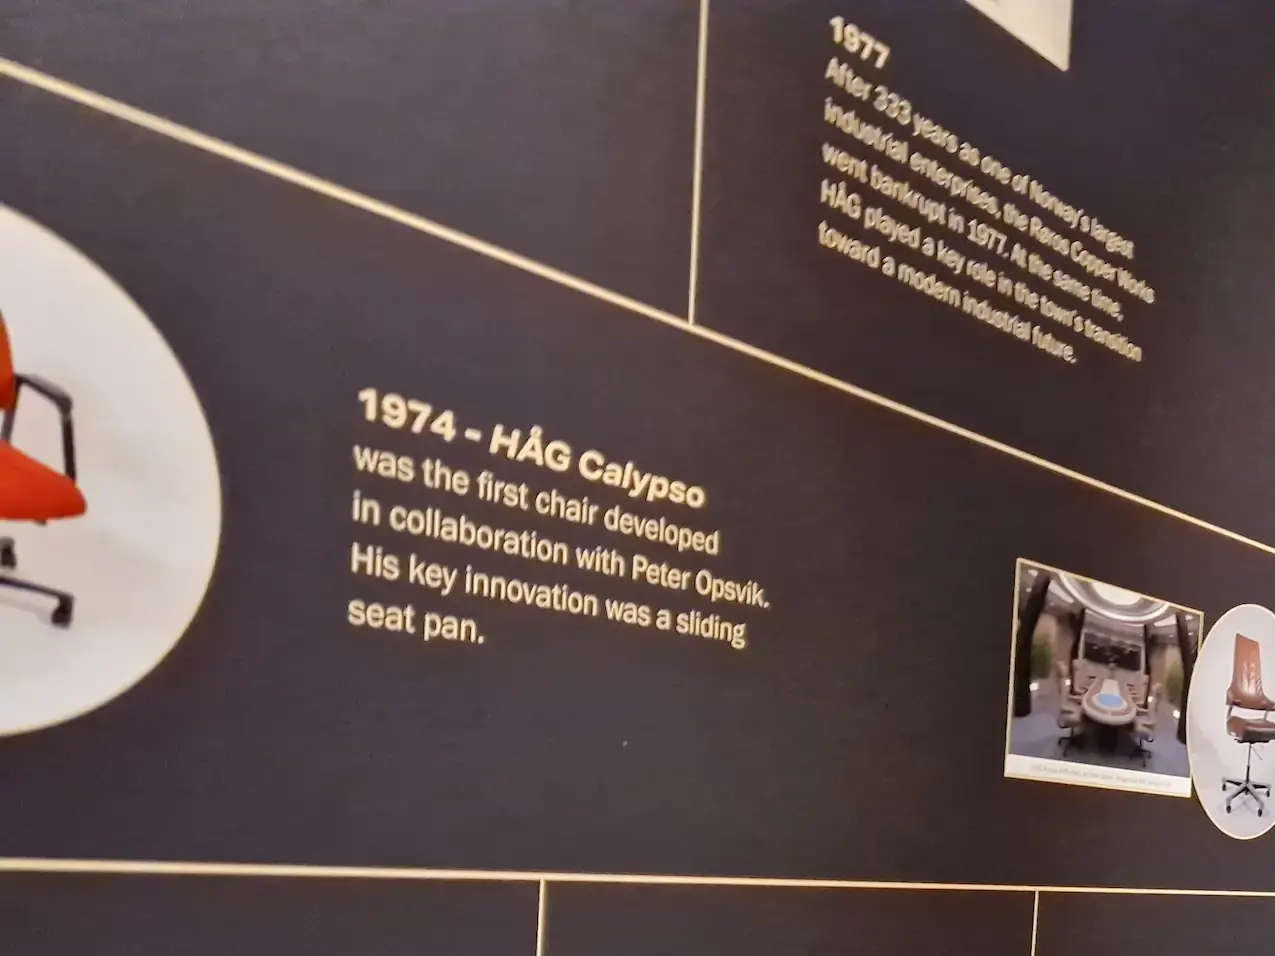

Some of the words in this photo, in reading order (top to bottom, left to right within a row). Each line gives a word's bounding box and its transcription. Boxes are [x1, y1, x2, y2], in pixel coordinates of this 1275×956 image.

[829, 16, 891, 70] 1977
[825, 59, 872, 100] After
[874, 86, 911, 125] 333
[912, 114, 958, 153] years
[959, 142, 980, 166] as
[981, 156, 1010, 184] one
[1012, 175, 1031, 199] of
[1030, 180, 1089, 232] Norway's
[1089, 218, 1134, 259] largest
[825, 99, 908, 163] industrial
[910, 152, 1001, 219] enterprises,
[1003, 203, 1028, 231] the
[1071, 241, 1117, 280] Copper
[1118, 268, 1154, 303] Works
[821, 179, 861, 219] HÅG
[864, 207, 920, 249] played
[922, 237, 934, 256] a
[937, 240, 965, 274] key
[967, 260, 996, 287] role
[998, 272, 1012, 296] in
[1014, 282, 1039, 309] the
[1040, 296, 1083, 332] town's
[1083, 319, 1142, 362] transition
[823, 143, 867, 183] went
[871, 167, 946, 224] bankrupt
[948, 208, 964, 233] in
[968, 219, 1009, 257] 1977.
[1011, 243, 1027, 268] At
[1028, 254, 1053, 281] the
[1053, 270, 1090, 301] same
[818, 221, 880, 268] toward
[882, 256, 895, 276] a
[898, 264, 960, 307] modern
[963, 291, 1031, 340] industrial
[1032, 326, 1076, 363] future.
[354, 446, 414, 481] was
[422, 459, 469, 494] the
[477, 472, 528, 510] first
[536, 489, 598, 525] chair
[604, 505, 719, 554] developed
[359, 389, 456, 441] 1974
[465, 429, 481, 441] -
[490, 424, 571, 471] HÅG
[579, 450, 705, 507] Calypso
[352, 542, 400, 580] His
[409, 554, 457, 595] key
[466, 565, 598, 616] innovation
[605, 599, 651, 626] was
[656, 610, 670, 630] a
[676, 610, 745, 649] sliding
[353, 490, 380, 525] in
[390, 506, 568, 565] collaboration
[576, 546, 625, 576] with
[632, 555, 691, 590] Peter
[696, 570, 769, 608] Opsvik.
[348, 600, 415, 634] seat
[424, 613, 484, 644] pan.
